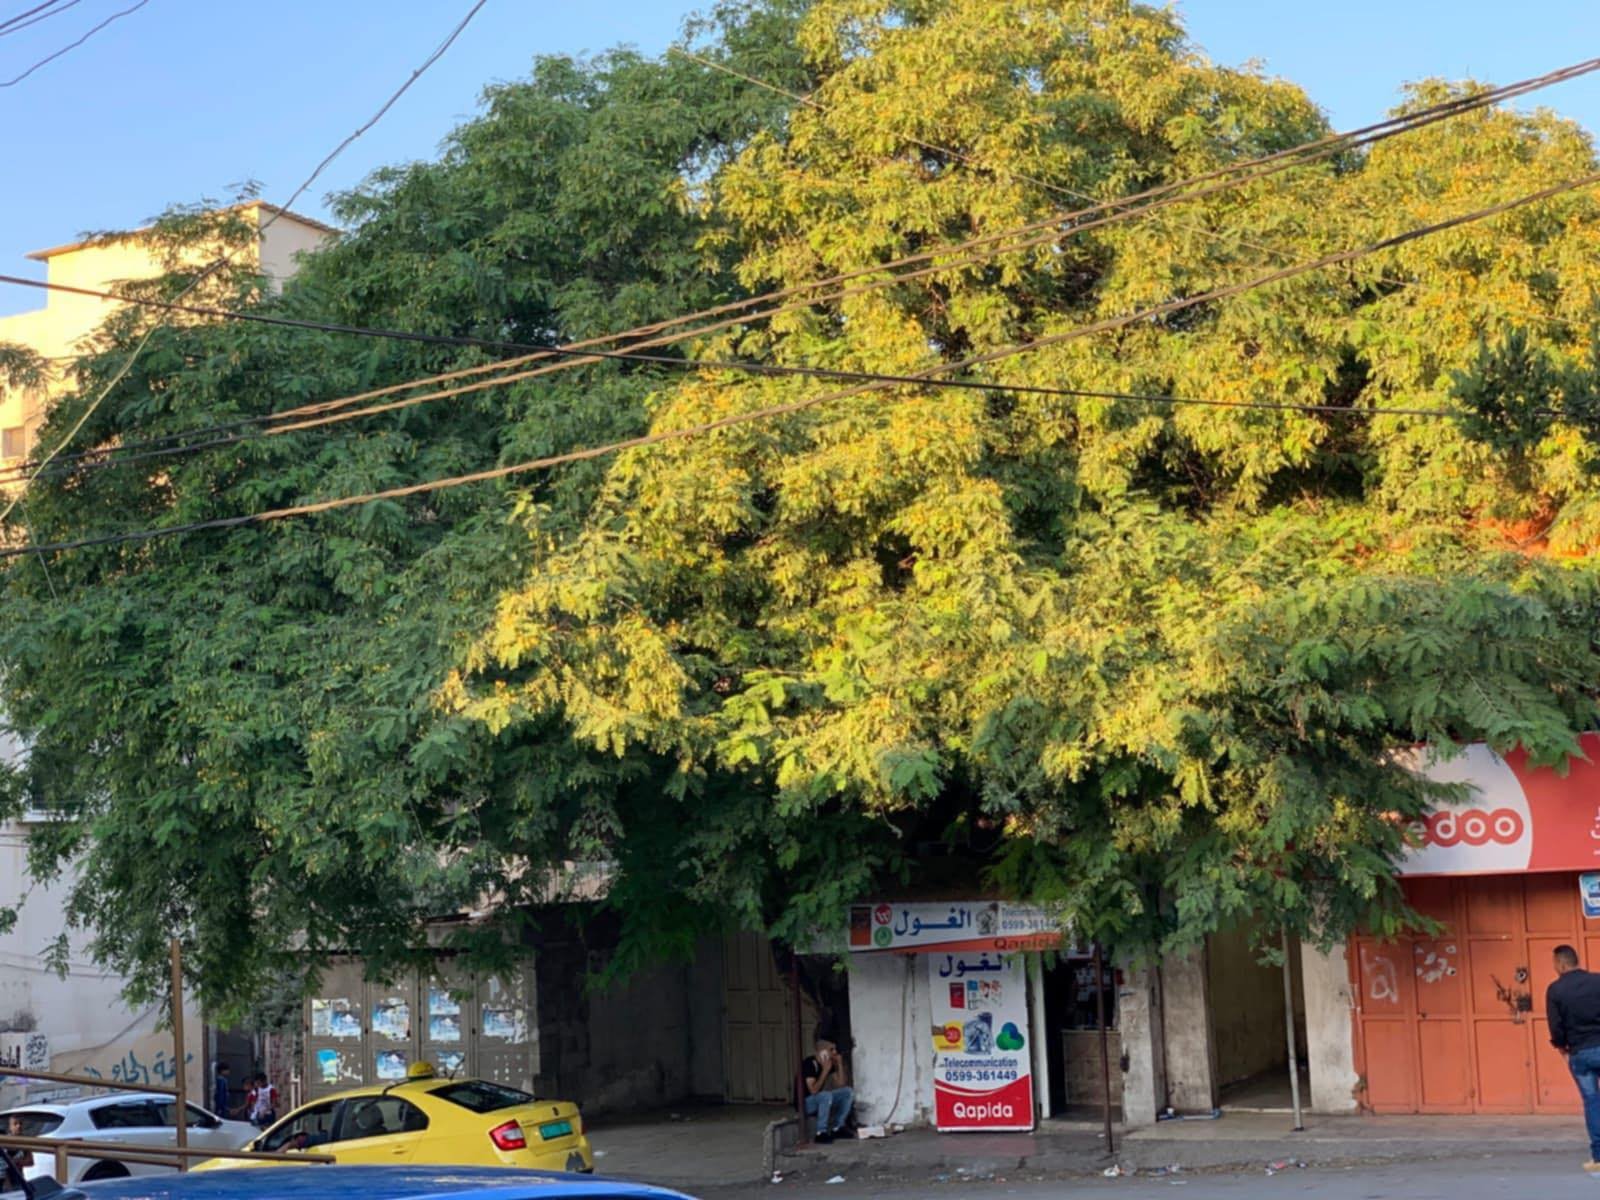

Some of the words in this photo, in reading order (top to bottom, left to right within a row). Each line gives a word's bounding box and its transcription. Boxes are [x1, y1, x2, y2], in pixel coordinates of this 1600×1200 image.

[1406, 811, 1516, 841] edoo
[894, 906, 971, 936] الغول
[945, 1070, 1018, 1082] 0599-361449
[953, 1101, 1013, 1120] Qapida
